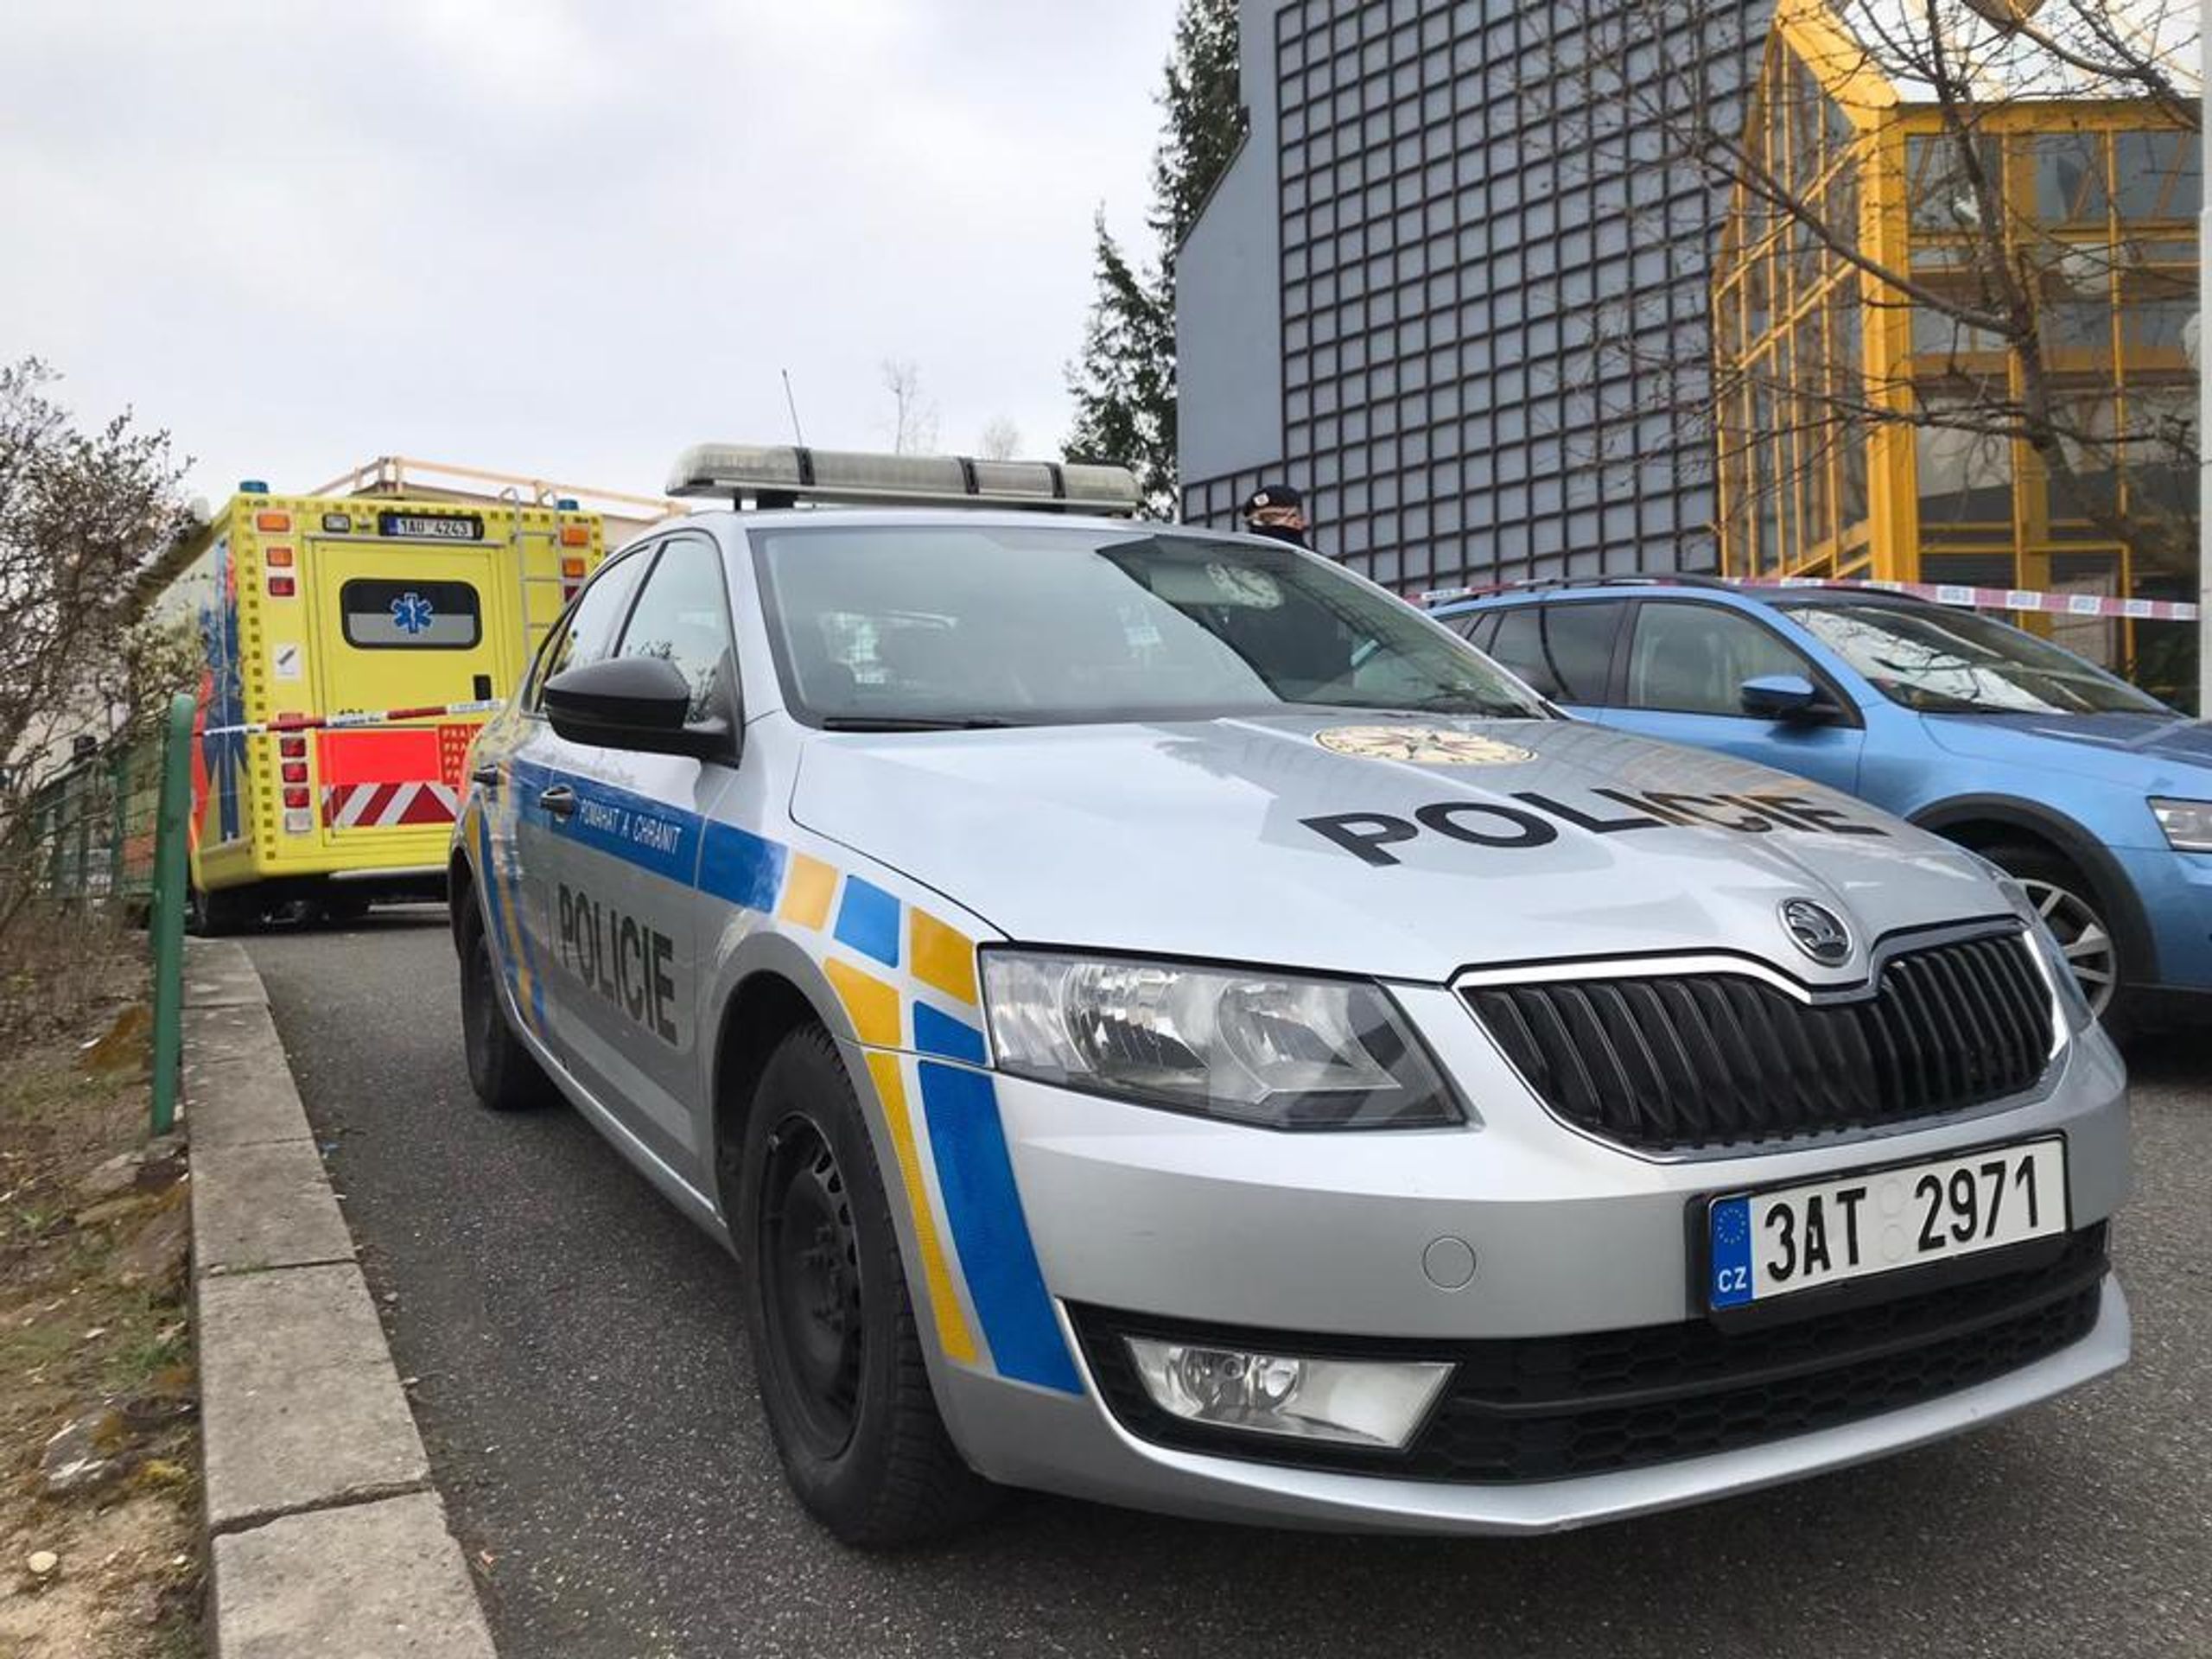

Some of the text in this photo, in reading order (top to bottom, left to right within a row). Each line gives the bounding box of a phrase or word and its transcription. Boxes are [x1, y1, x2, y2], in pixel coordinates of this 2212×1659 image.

[620, 811, 631, 839] A
[1296, 787, 1891, 868] POLICIE
[558, 881, 678, 1047] POLICIE
[1764, 1154, 2039, 1282] 3AT 2971
[1718, 1265, 1747, 1294] CZ
